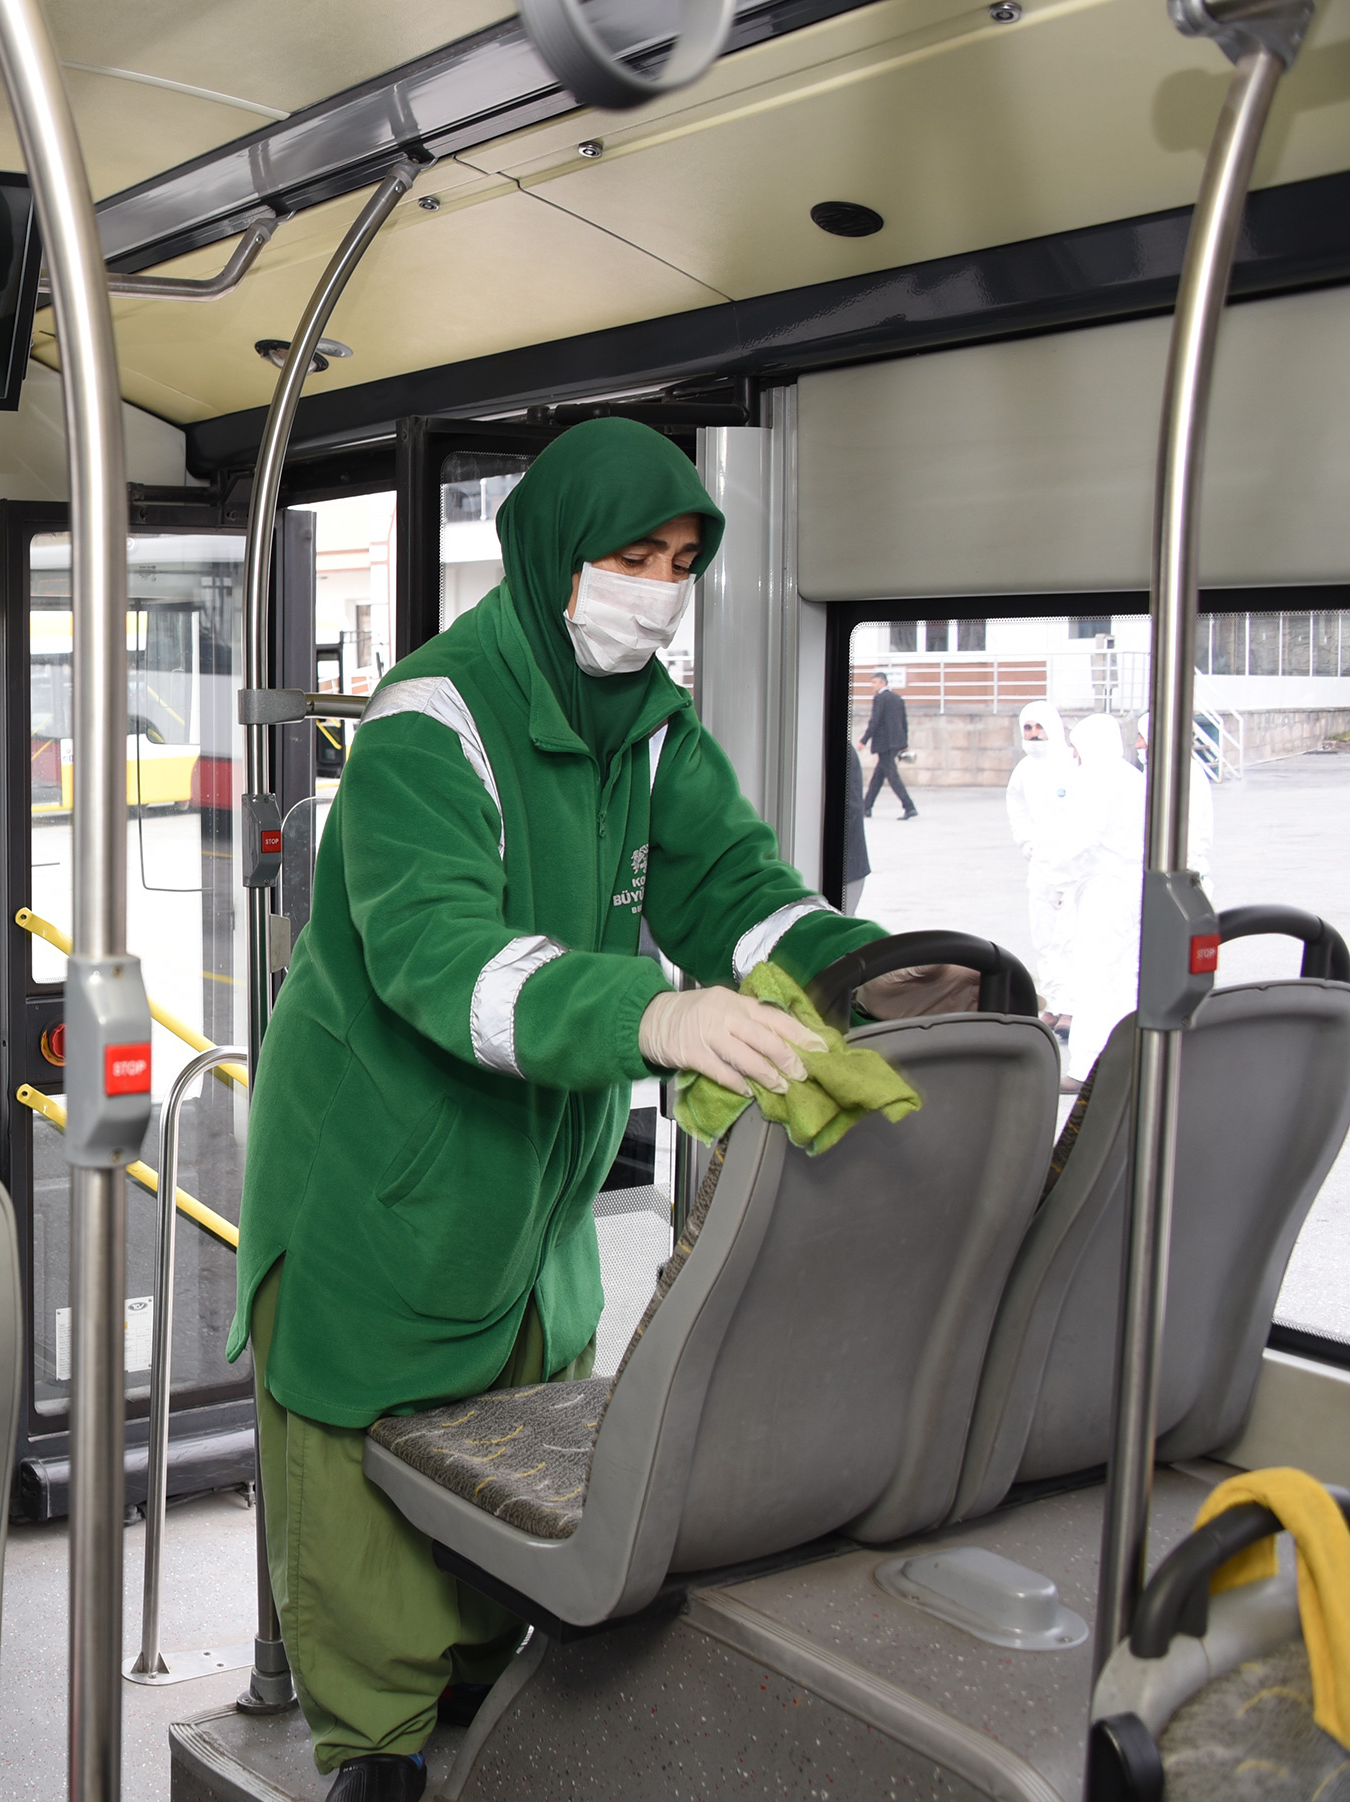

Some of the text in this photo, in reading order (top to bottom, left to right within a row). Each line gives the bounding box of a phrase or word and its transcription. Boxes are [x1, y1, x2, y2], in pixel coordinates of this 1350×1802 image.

[265, 837, 279, 845] STOP
[1196, 948, 1216, 960] STOP
[113, 1060, 146, 1077] STOP
